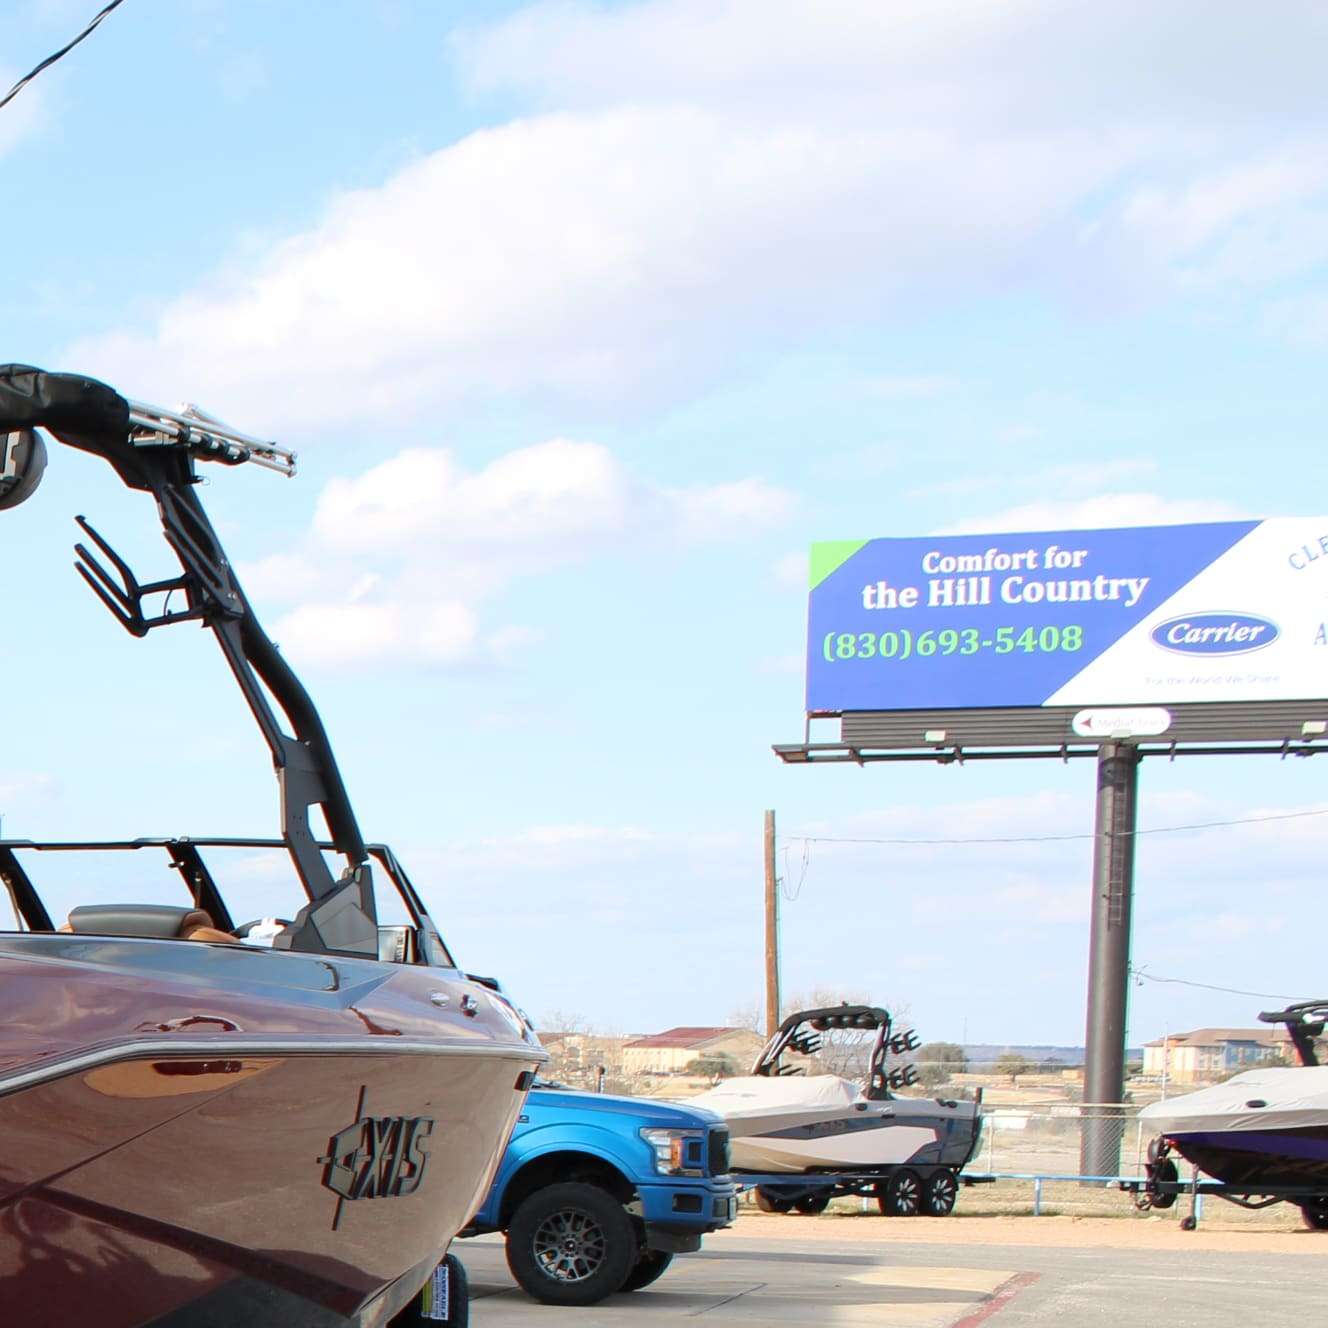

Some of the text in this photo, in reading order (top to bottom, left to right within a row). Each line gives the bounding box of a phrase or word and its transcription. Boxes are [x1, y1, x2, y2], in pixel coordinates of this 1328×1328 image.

[921, 546, 1088, 574] Comfort for
[862, 574, 1151, 610] the Hill Country
[822, 625, 1083, 662] (830)693-5408
[1166, 622, 1266, 644] Carrier
